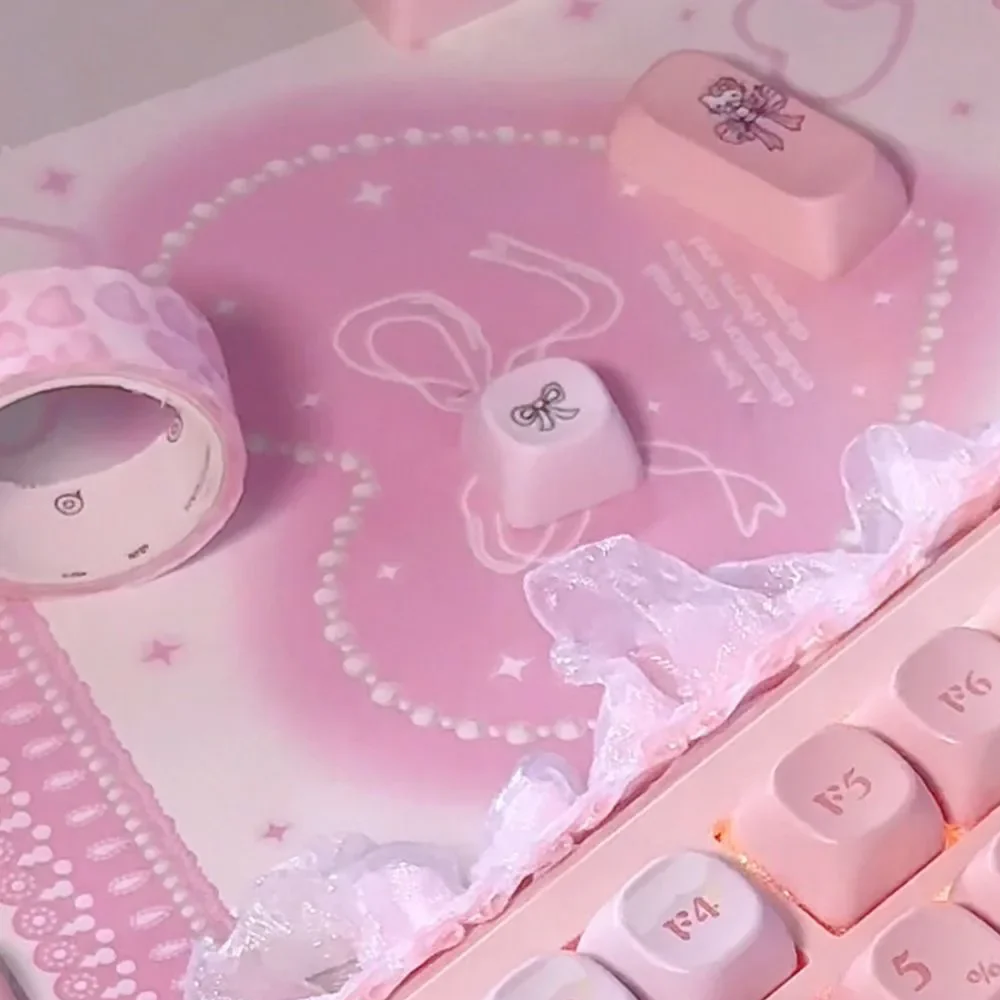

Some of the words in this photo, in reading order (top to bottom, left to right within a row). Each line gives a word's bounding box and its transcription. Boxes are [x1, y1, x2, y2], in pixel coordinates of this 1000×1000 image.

[938, 670, 992, 713] F6
[813, 768, 872, 816] F5
[662, 896, 720, 940] F4
[892, 949, 932, 992] 5
